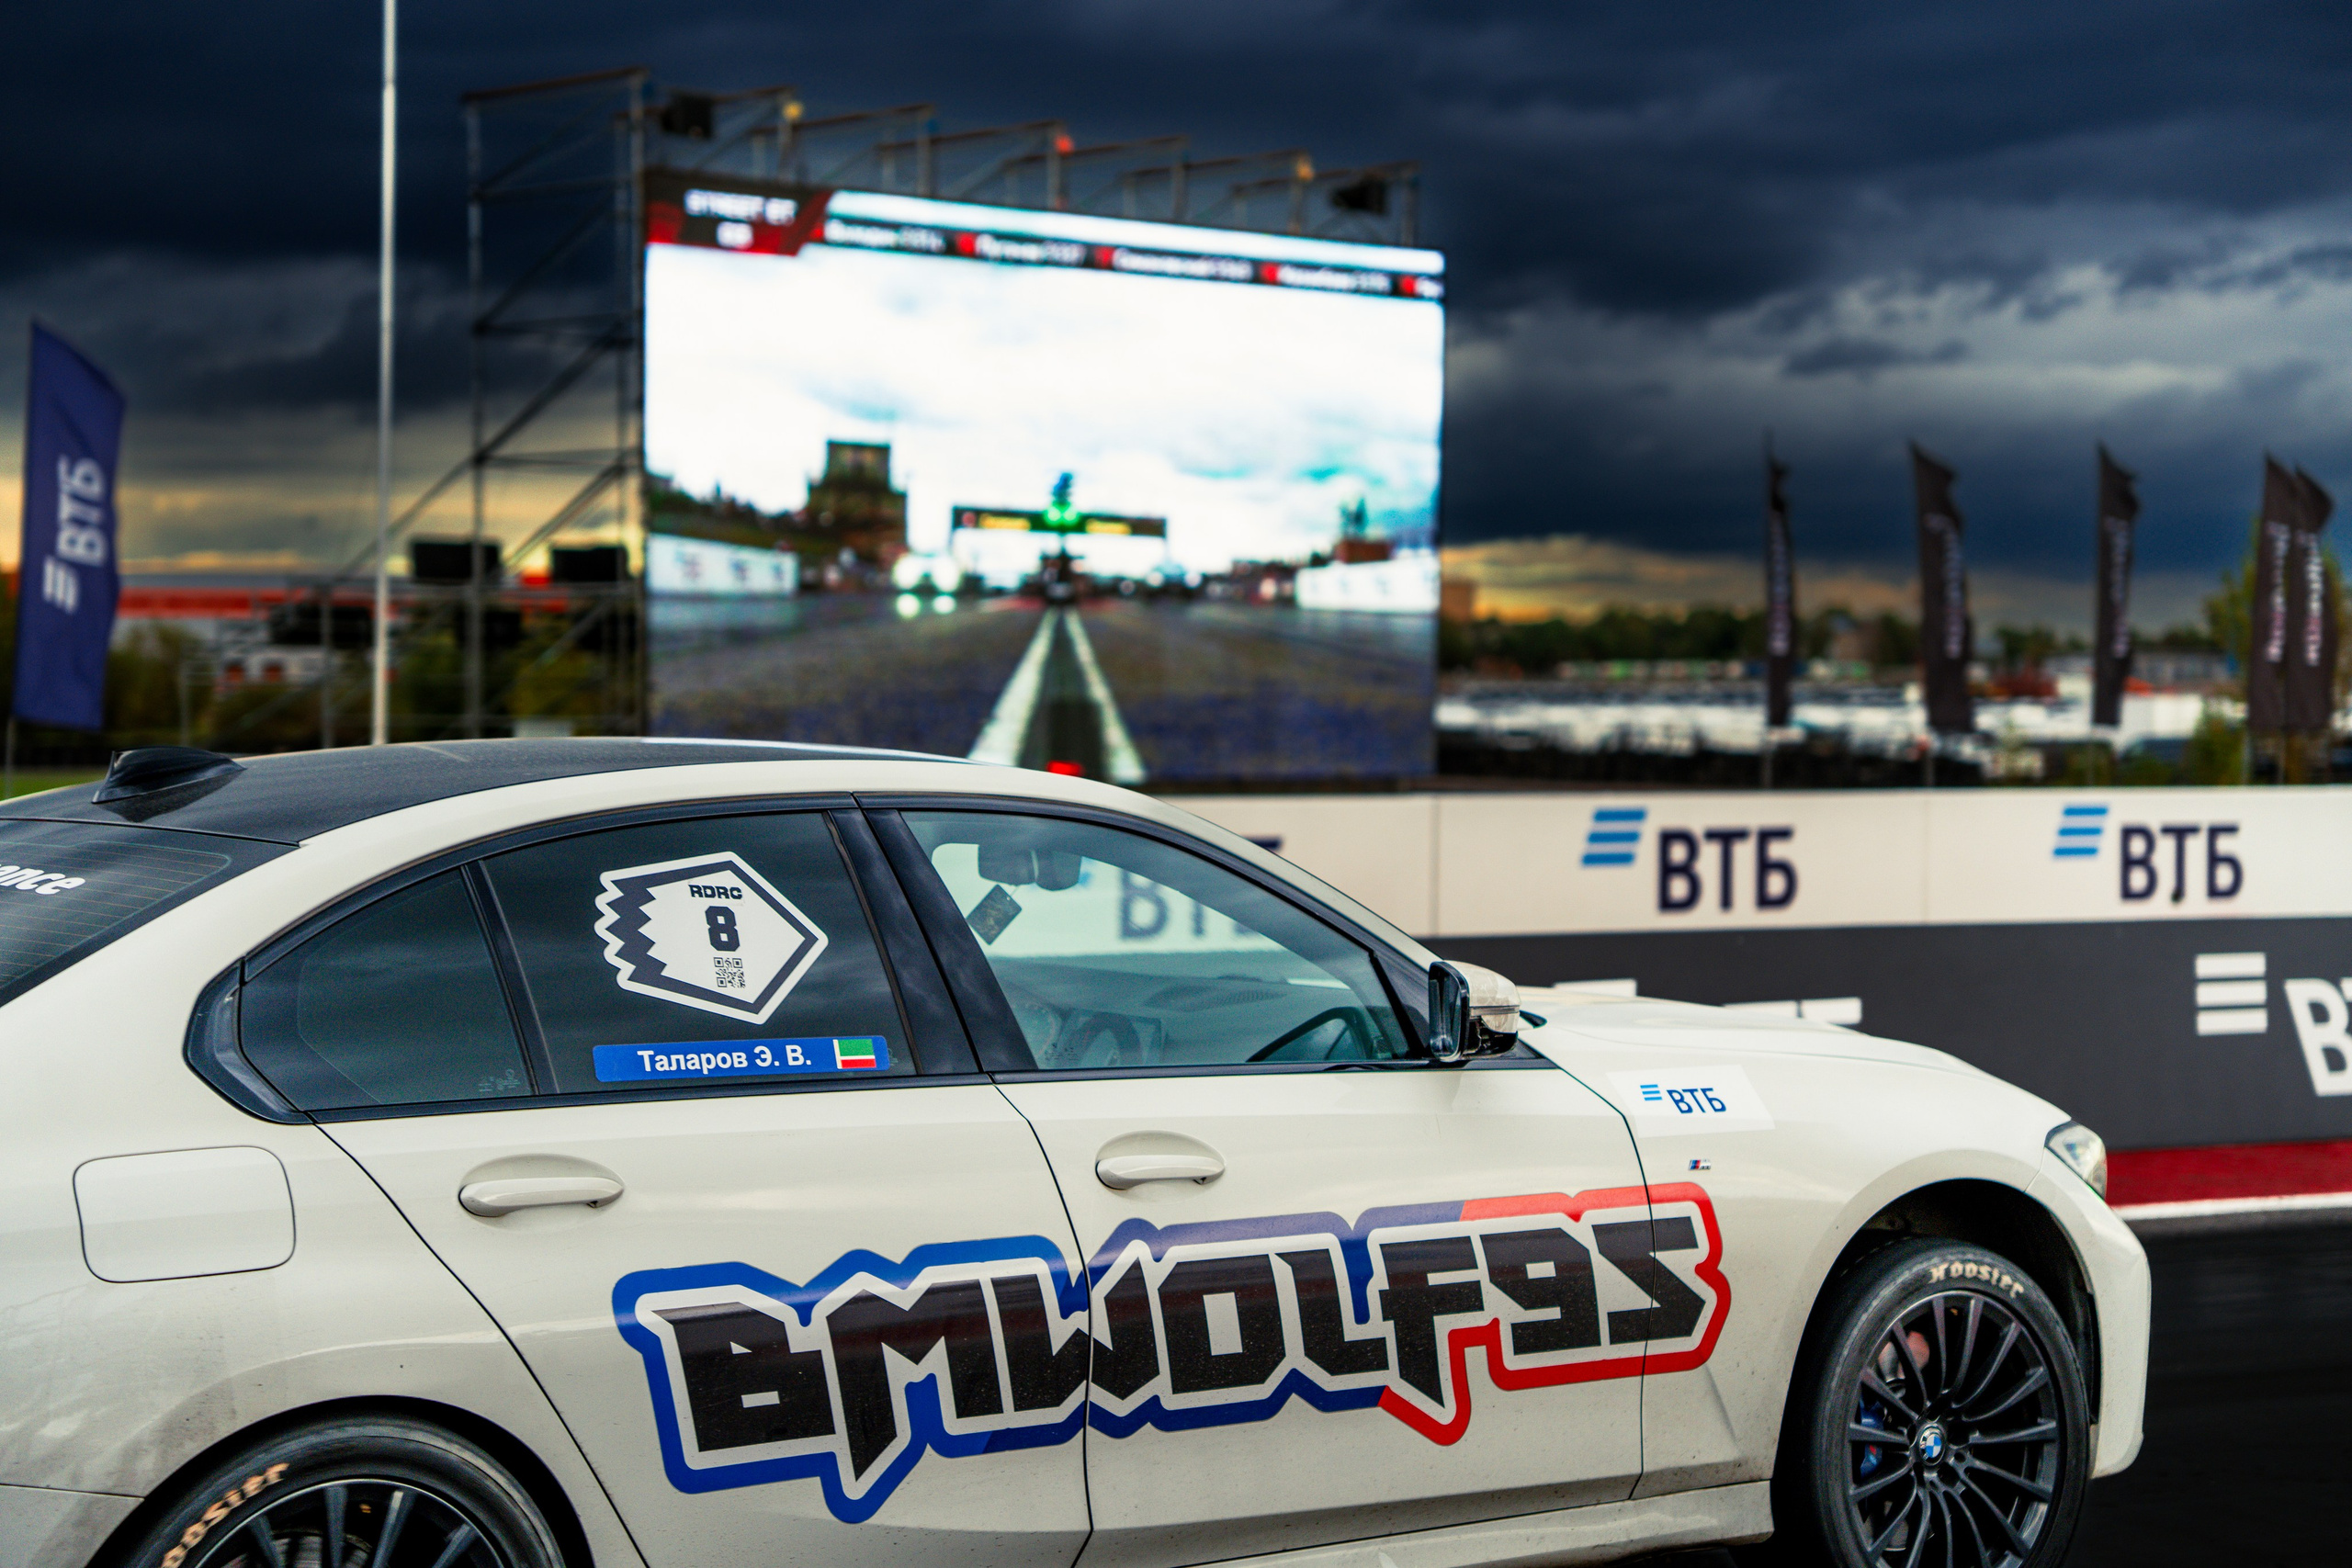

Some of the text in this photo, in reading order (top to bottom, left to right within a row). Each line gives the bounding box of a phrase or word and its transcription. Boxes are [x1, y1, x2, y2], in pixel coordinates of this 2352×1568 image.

[56, 456, 106, 568] ВТБ
[689, 884, 742, 899] RDRC
[1657, 827, 1798, 913] ВТБ
[2120, 824, 2244, 903] ВТБ
[705, 906, 741, 952] 8
[638, 1044, 811, 1075] Таларов Э. В.
[2284, 977, 2352, 1097] В
[1666, 1088, 1726, 1113] ВТБ
